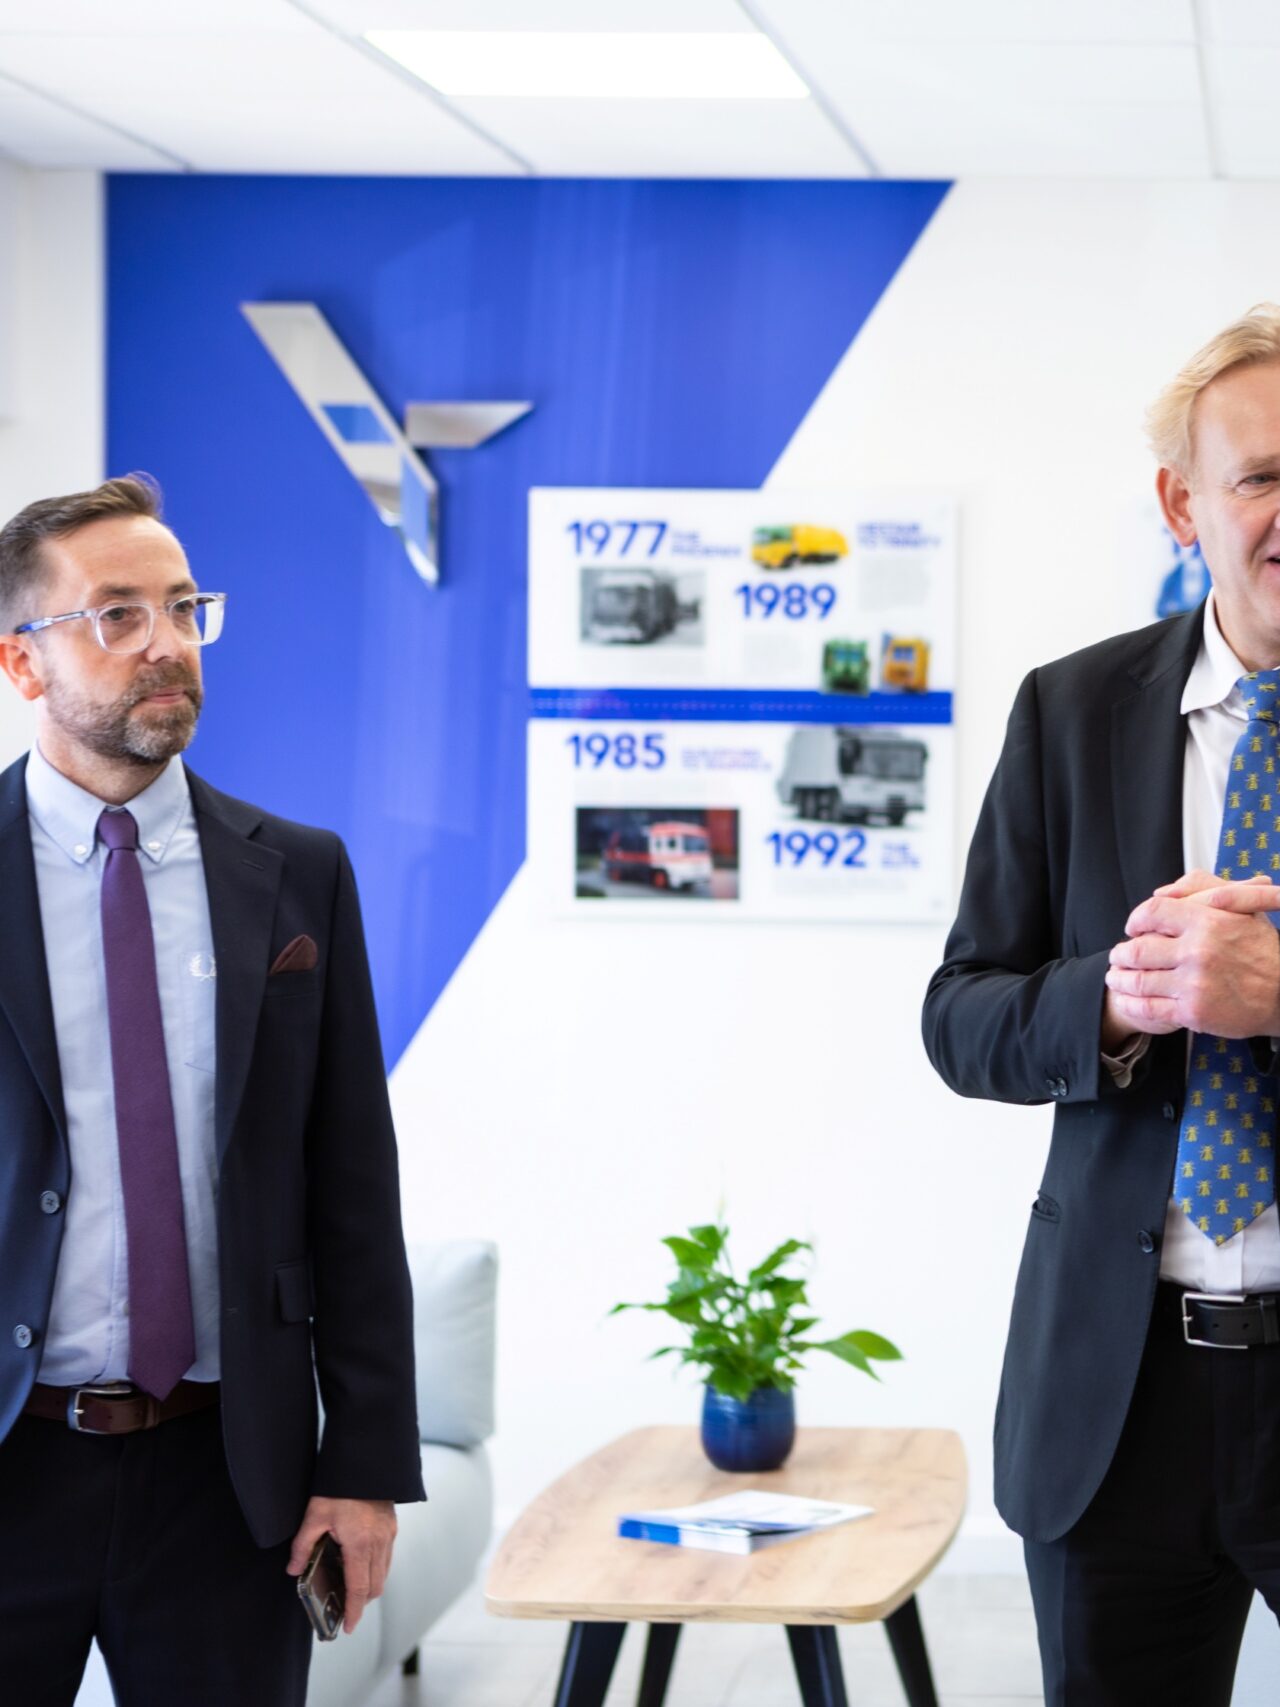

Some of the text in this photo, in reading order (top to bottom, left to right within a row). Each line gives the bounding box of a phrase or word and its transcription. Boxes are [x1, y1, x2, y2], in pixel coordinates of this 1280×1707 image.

[568, 520, 668, 556] 1977
[735, 582, 836, 620] 1989
[567, 732, 666, 770] 1985
[766, 829, 867, 869] 1992
